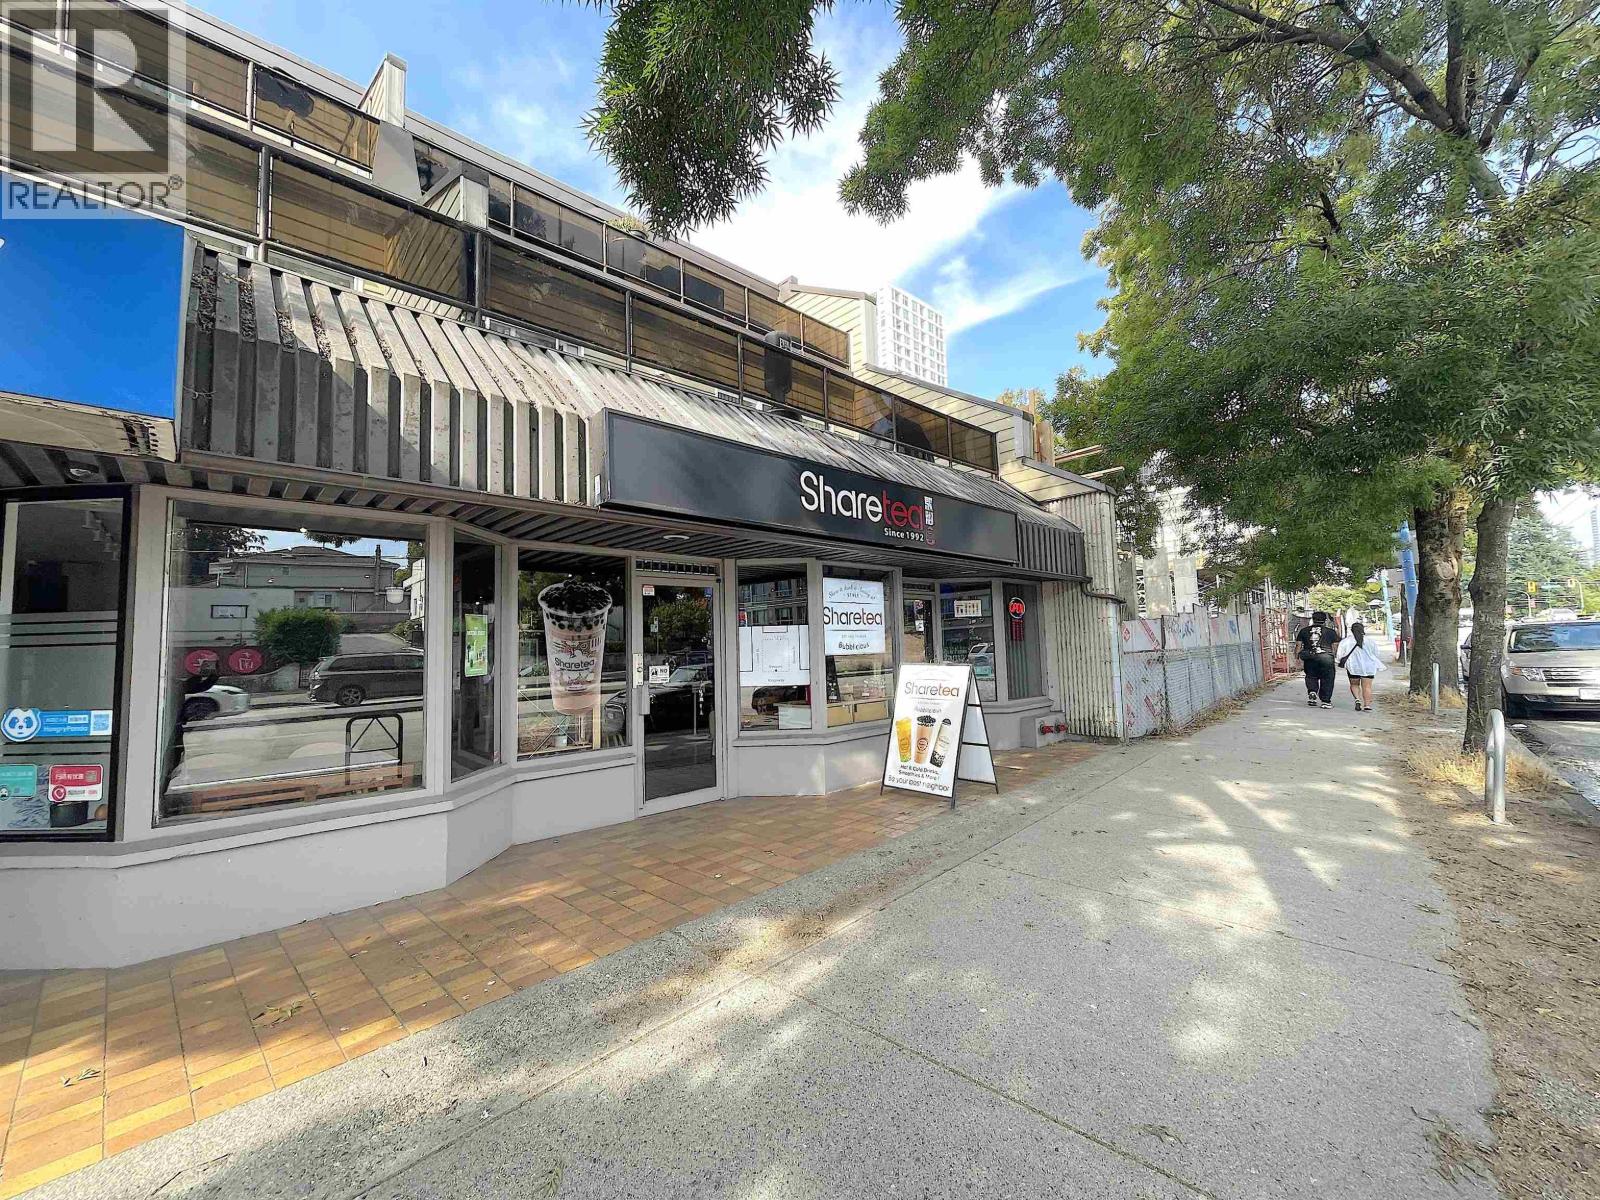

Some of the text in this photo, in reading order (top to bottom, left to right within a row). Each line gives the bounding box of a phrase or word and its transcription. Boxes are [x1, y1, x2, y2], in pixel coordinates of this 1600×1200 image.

[800, 470, 924, 531] Sharetea
[884, 527, 924, 542] Since 1992
[823, 606, 883, 626] Sharetea
[554, 657, 595, 670] Sharetea
[904, 681, 960, 698] Sharetea
